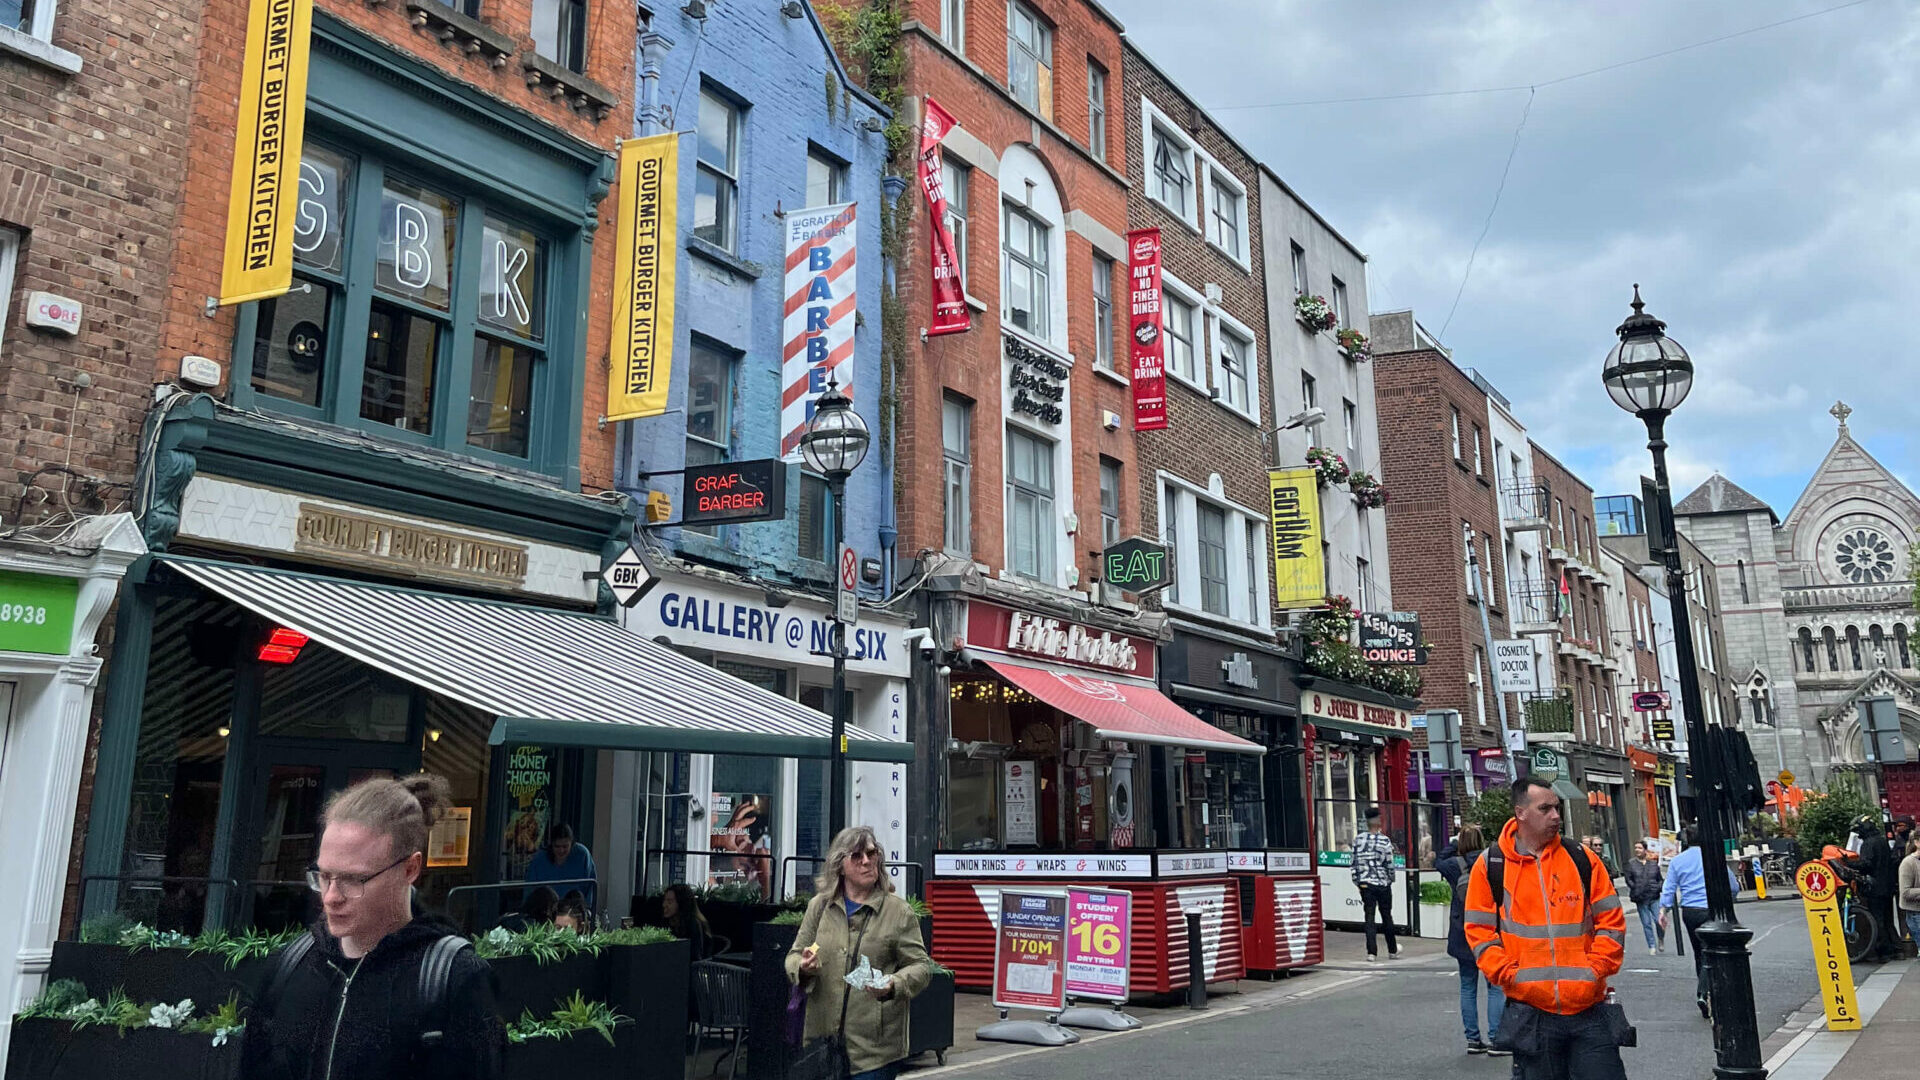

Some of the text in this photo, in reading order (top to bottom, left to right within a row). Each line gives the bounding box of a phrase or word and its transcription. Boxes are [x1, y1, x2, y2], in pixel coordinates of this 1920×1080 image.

[260, 79, 283, 166] BURGER
[250, 171, 276, 271] KITCHEN
[802, 212, 851, 228] GRAFTON
[792, 219, 802, 242] THE
[802, 226, 846, 241] BARBER
[630, 158, 657, 395] GOURMET BURGER KITCHEN
[1133, 264, 1156, 279] AIN'T
[1139, 278, 1151, 290] NO
[1132, 288, 1159, 303] FINER
[39, 303, 78, 323] CORE
[1132, 301, 1160, 316] DINER
[1139, 356, 1156, 368] EAT
[1134, 367, 1162, 380] DRINK
[695, 473, 739, 492] GRAF
[699, 491, 764, 512] BARBER
[1273, 486, 1313, 560] GOTHAM
[299, 513, 528, 577] GOURMET BURGER KITCHEN
[1108, 549, 1165, 583] EAT
[613, 567, 640, 586] GBK
[0, 603, 46, 625] 8938
[1387, 613, 1417, 623] WINES
[660, 592, 780, 644] GALLERY
[785, 617, 804, 649] @
[855, 628, 888, 661] SIX
[1363, 614, 1414, 647] KEHOES
[1363, 649, 1417, 662] LOUNGE
[1497, 645, 1530, 657] COSMETIC
[1501, 660, 1529, 672] DOCTOR
[1313, 694, 1322, 714] 9
[1328, 698, 1360, 721] JOHN
[1363, 704, 1397, 728] KEHOE
[1400, 711, 1407, 729] 9
[510, 755, 548, 770] HONEY
[955, 859, 1127, 872] ONION RINGS & WRAPS & WINGS
[1076, 903, 1120, 914] STUDENT
[1006, 912, 1061, 923] SUNDAY OPENING
[1080, 912, 1115, 923] OFFER!
[1019, 932, 1042, 940] NEAREST
[1076, 955, 1115, 965] DRY TRIM
[1819, 914, 1847, 1017] TAILORING
[1069, 964, 1121, 975] MONDAY FRIDAY
